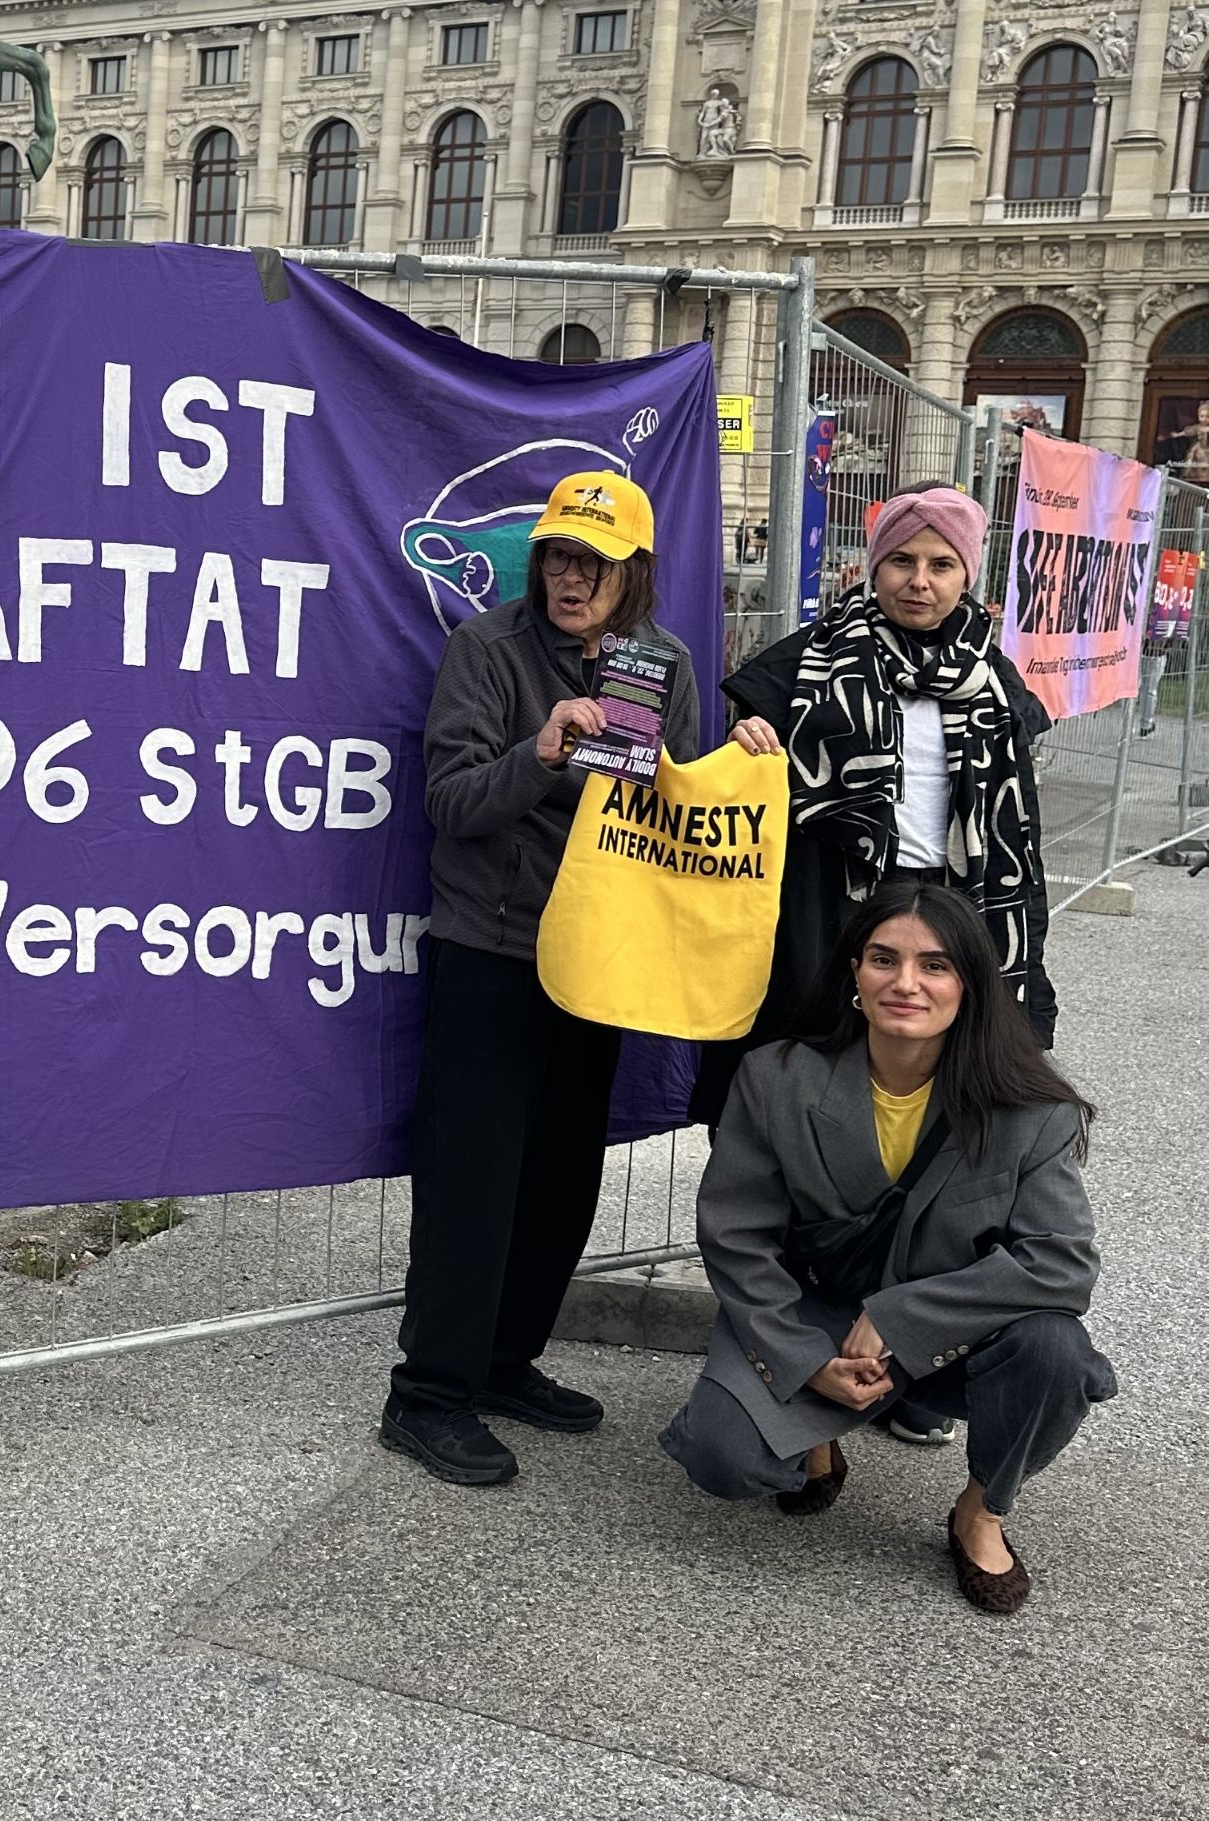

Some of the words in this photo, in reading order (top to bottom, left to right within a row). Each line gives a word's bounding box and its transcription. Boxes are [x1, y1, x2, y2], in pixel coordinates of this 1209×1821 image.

[103, 362, 315, 505] IST
[139, 727, 392, 832] StGB
[571, 748, 626, 769] AUTONOMY
[625, 757, 658, 776] BODILY
[629, 745, 657, 761] SLAM
[601, 780, 766, 848] AMNESTY
[597, 824, 765, 879] INTERNATIONAL
